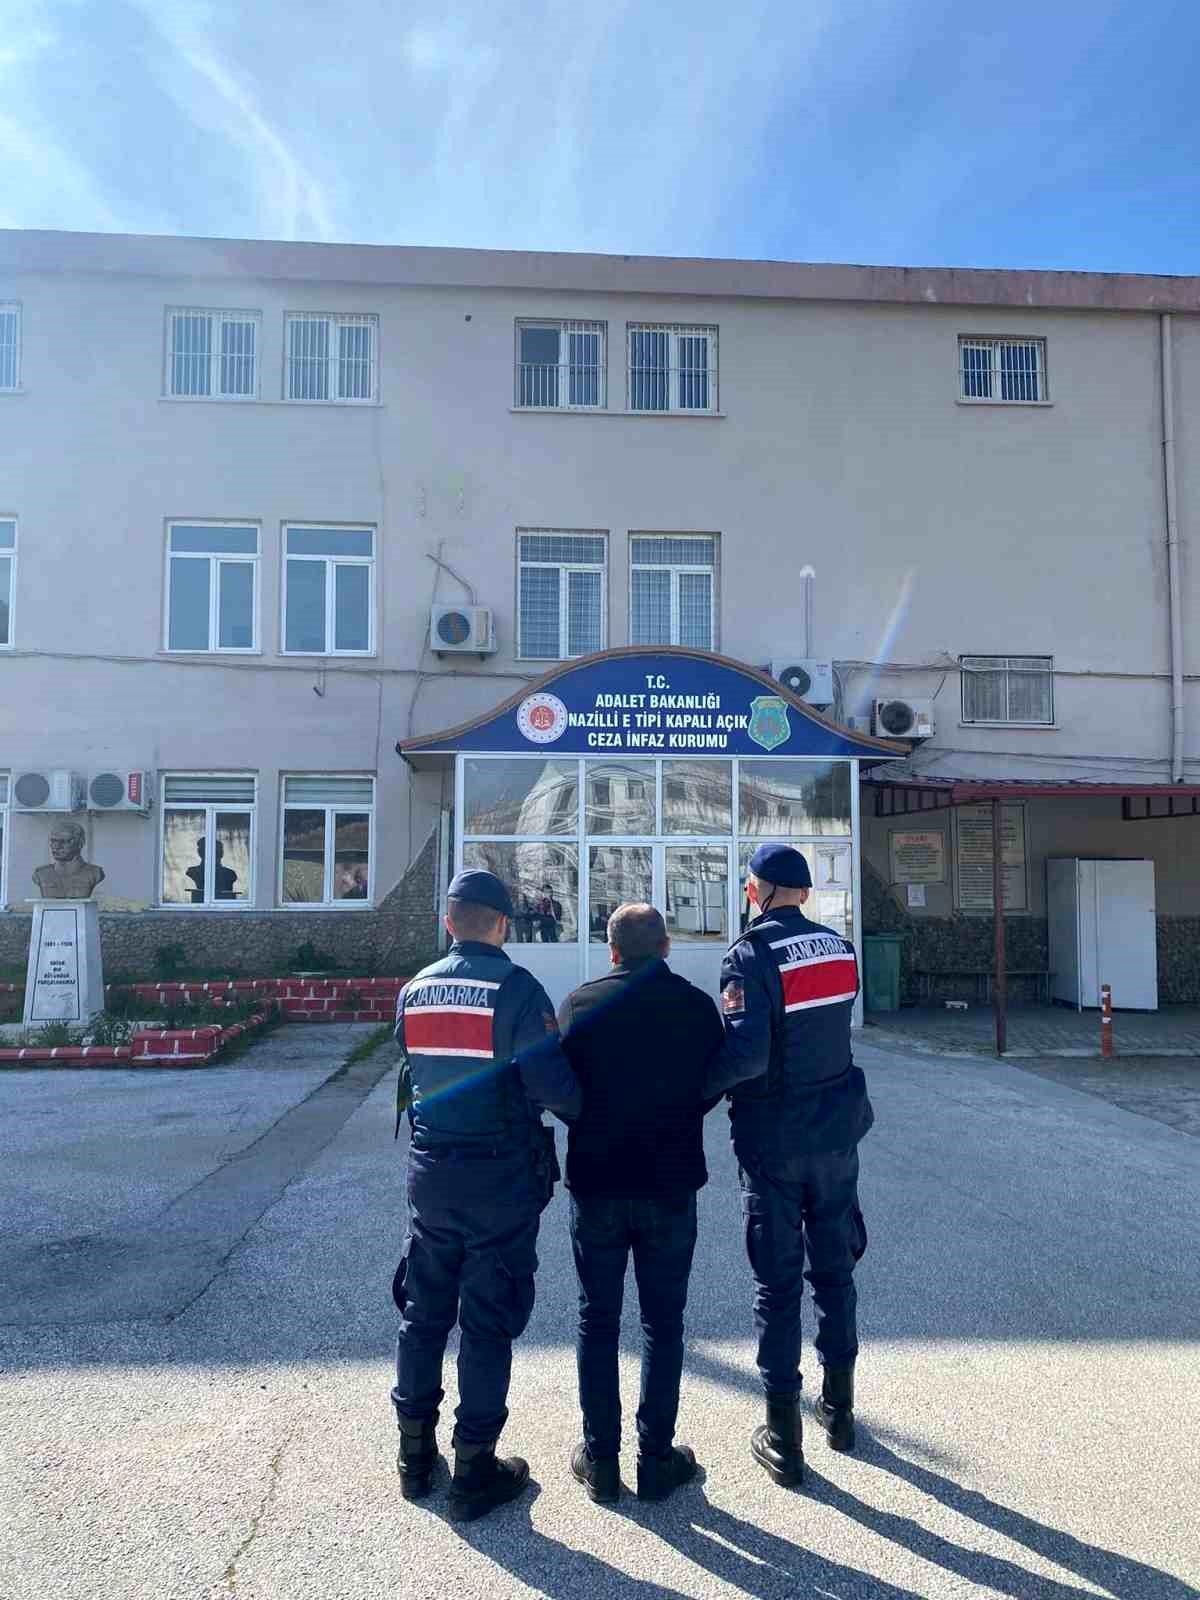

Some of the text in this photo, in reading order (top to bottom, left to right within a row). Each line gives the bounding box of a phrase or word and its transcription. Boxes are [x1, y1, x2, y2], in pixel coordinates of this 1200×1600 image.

[645, 675, 670, 689] T.C.
[595, 692, 721, 709] ADALET BAKANLIĞI
[568, 711, 748, 732] NAZİLLİ E TİPİ KAPALI AÇIK
[588, 730, 728, 748] CEZA İNFAZ KURUMU
[786, 938, 848, 961] JANDARMA
[412, 984, 489, 1006] JANDARMA
